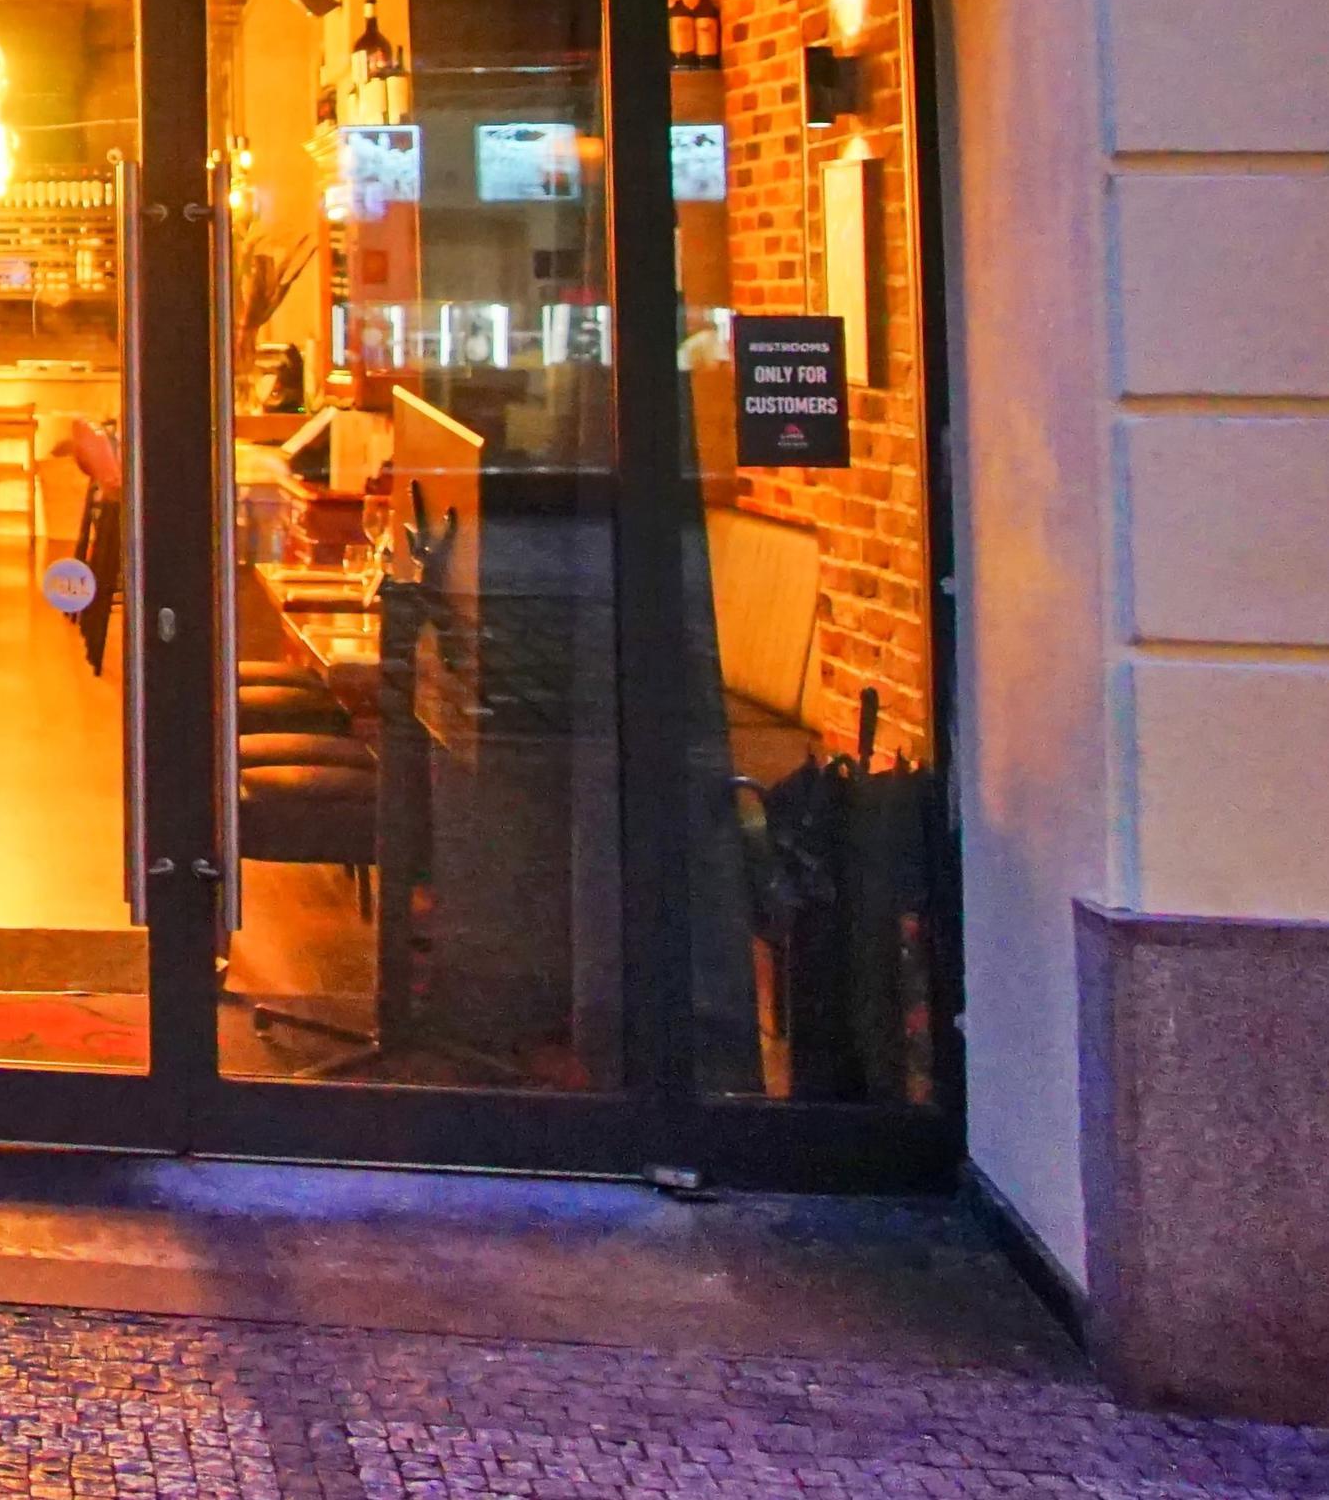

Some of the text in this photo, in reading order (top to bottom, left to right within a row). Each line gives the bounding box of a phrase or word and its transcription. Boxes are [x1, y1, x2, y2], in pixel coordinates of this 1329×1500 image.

[754, 365, 827, 384] ONLY FOR
[745, 396, 838, 415] CUSTOMERS
